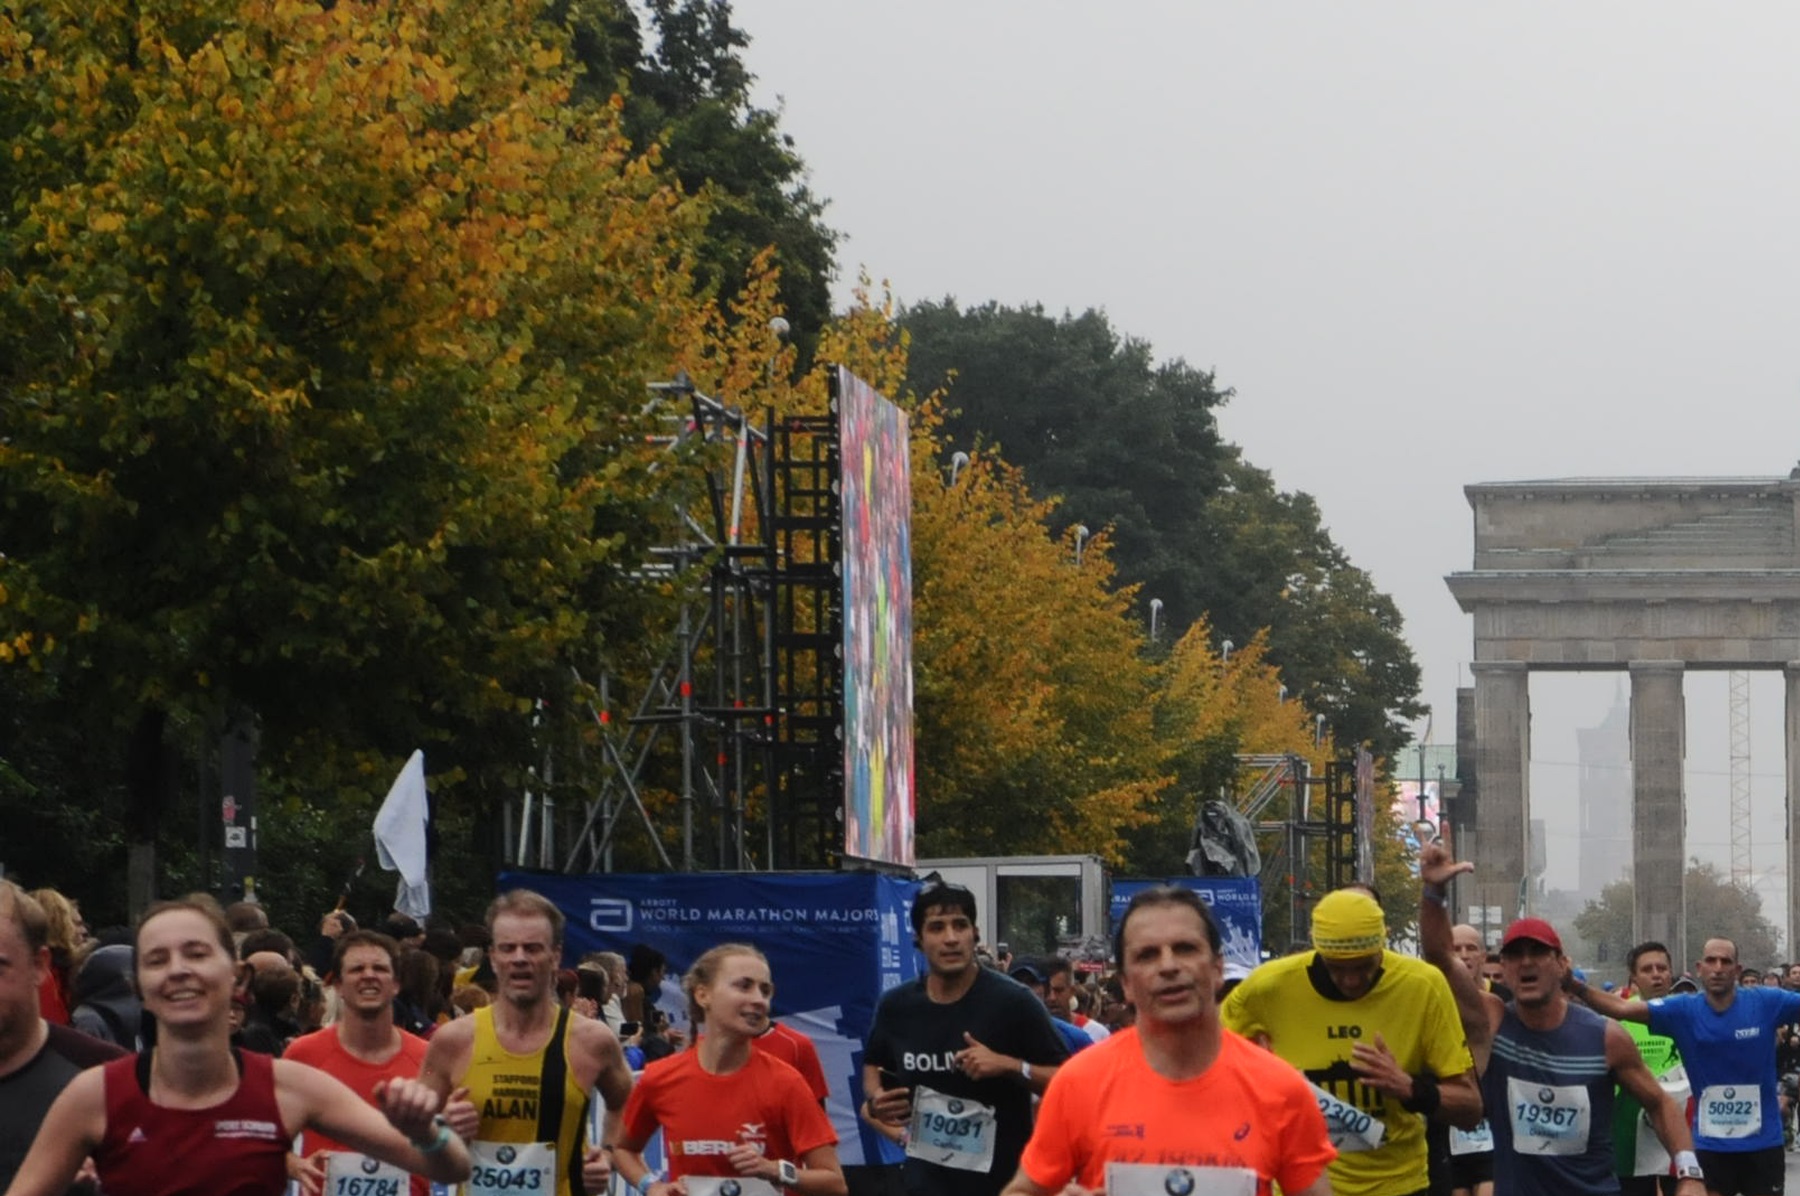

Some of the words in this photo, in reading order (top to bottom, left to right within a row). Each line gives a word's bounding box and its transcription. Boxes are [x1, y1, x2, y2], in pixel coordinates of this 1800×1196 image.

[640, 908, 702, 921] WORLD
[707, 908, 807, 922] MARATHON
[1327, 1025, 1362, 1039] LEO
[492, 1074, 539, 1086] STAFFORD
[482, 1098, 538, 1121] ALAN
[1516, 1102, 1579, 1127] 19367
[1708, 1101, 1753, 1116] 50922
[922, 1112, 984, 1139] 19031
[471, 1165, 542, 1190] 25043
